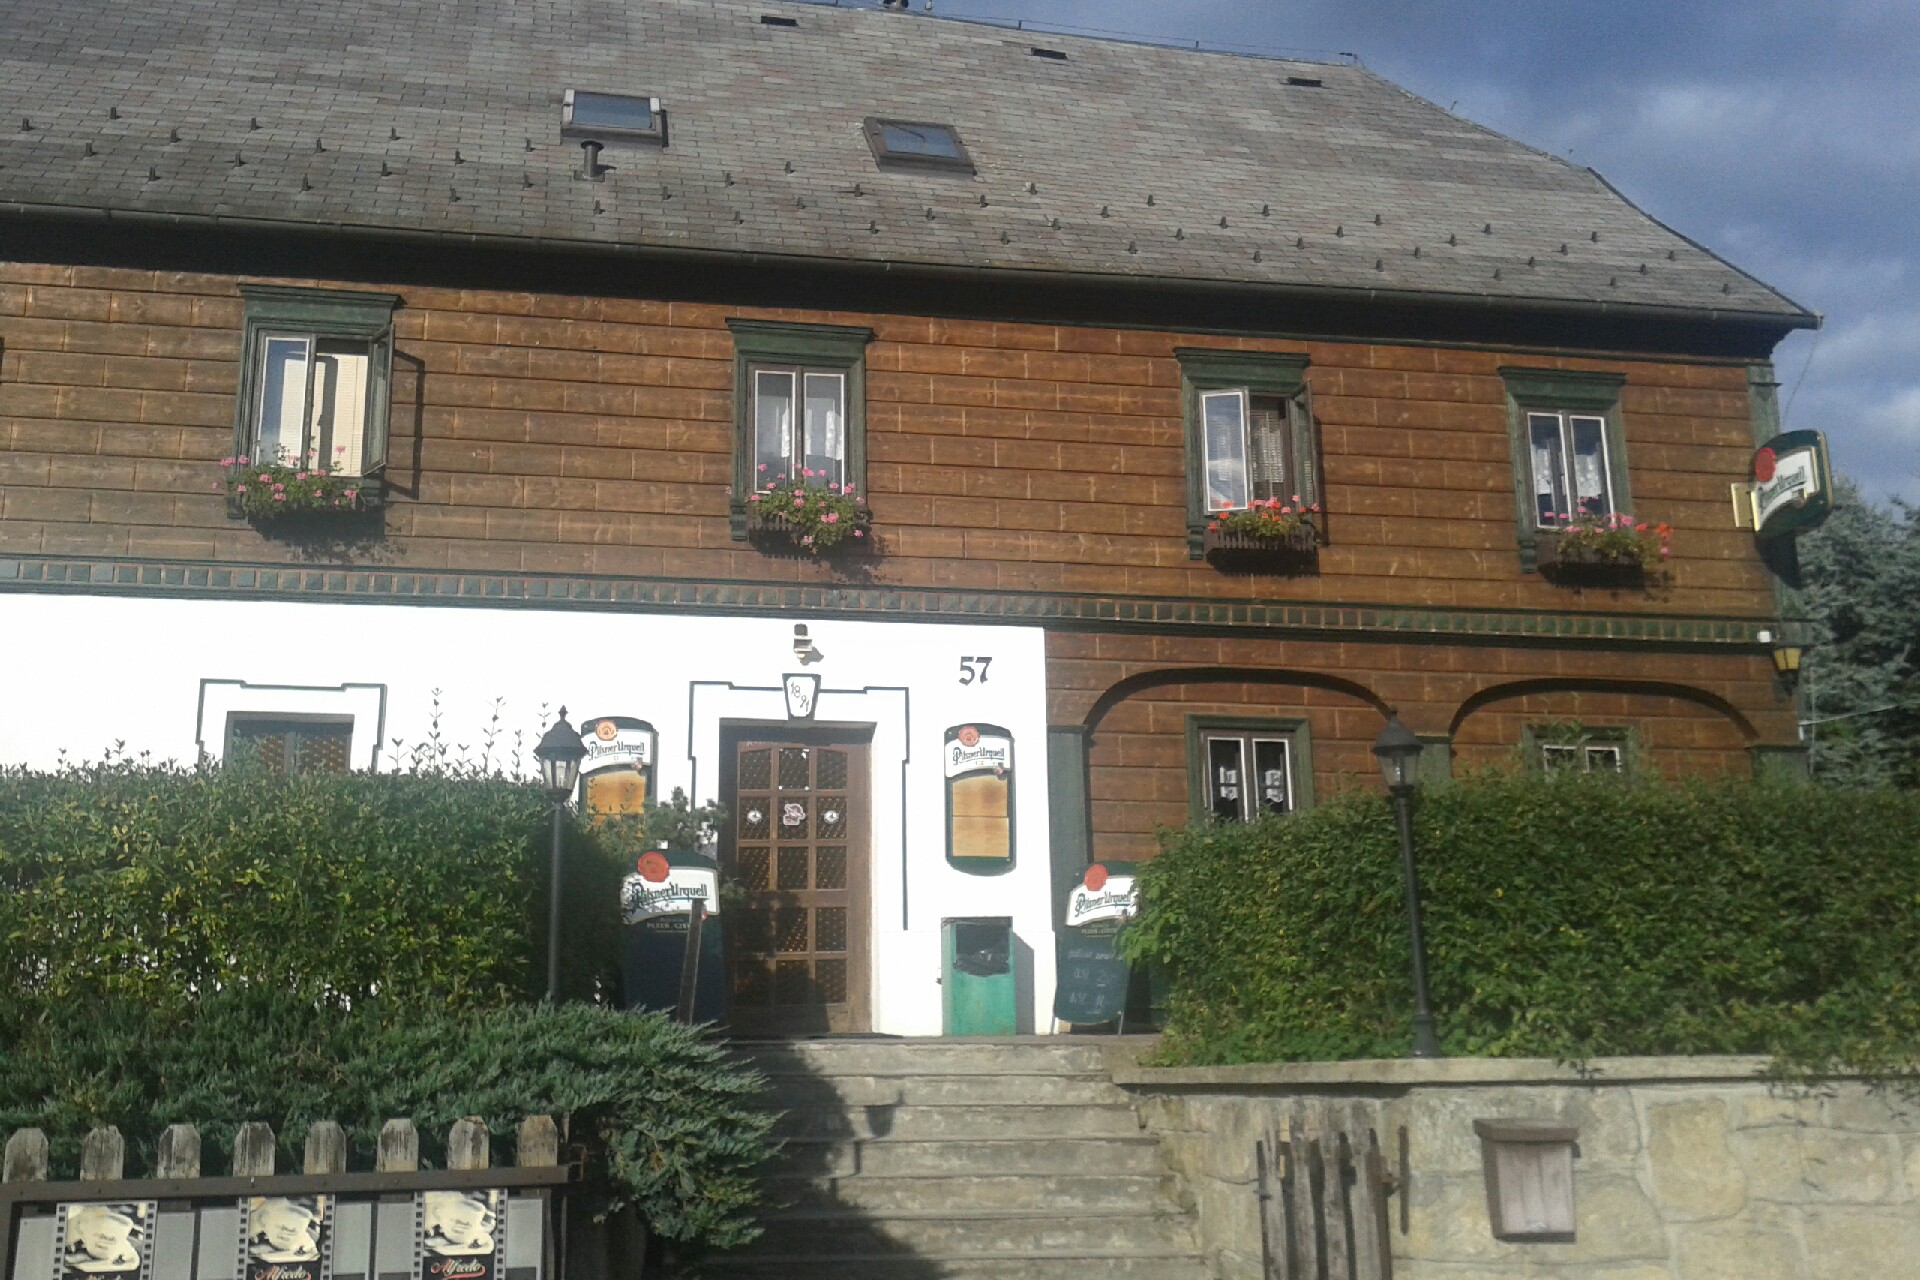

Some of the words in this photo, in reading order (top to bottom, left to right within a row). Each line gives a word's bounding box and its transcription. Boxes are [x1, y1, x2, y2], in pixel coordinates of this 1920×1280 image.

[959, 656, 992, 686] 57
[589, 741, 617, 760] Pilsner
[617, 740, 644, 756] Urquell
[953, 746, 980, 765] Pilsner
[979, 746, 1004, 761] Urquell
[632, 882, 671, 906] Pilsner
[669, 882, 707, 902] Urquell
[1074, 893, 1104, 918] Pilsner
[1104, 891, 1131, 909] Urquell
[431, 1257, 481, 1277] Alfredo
